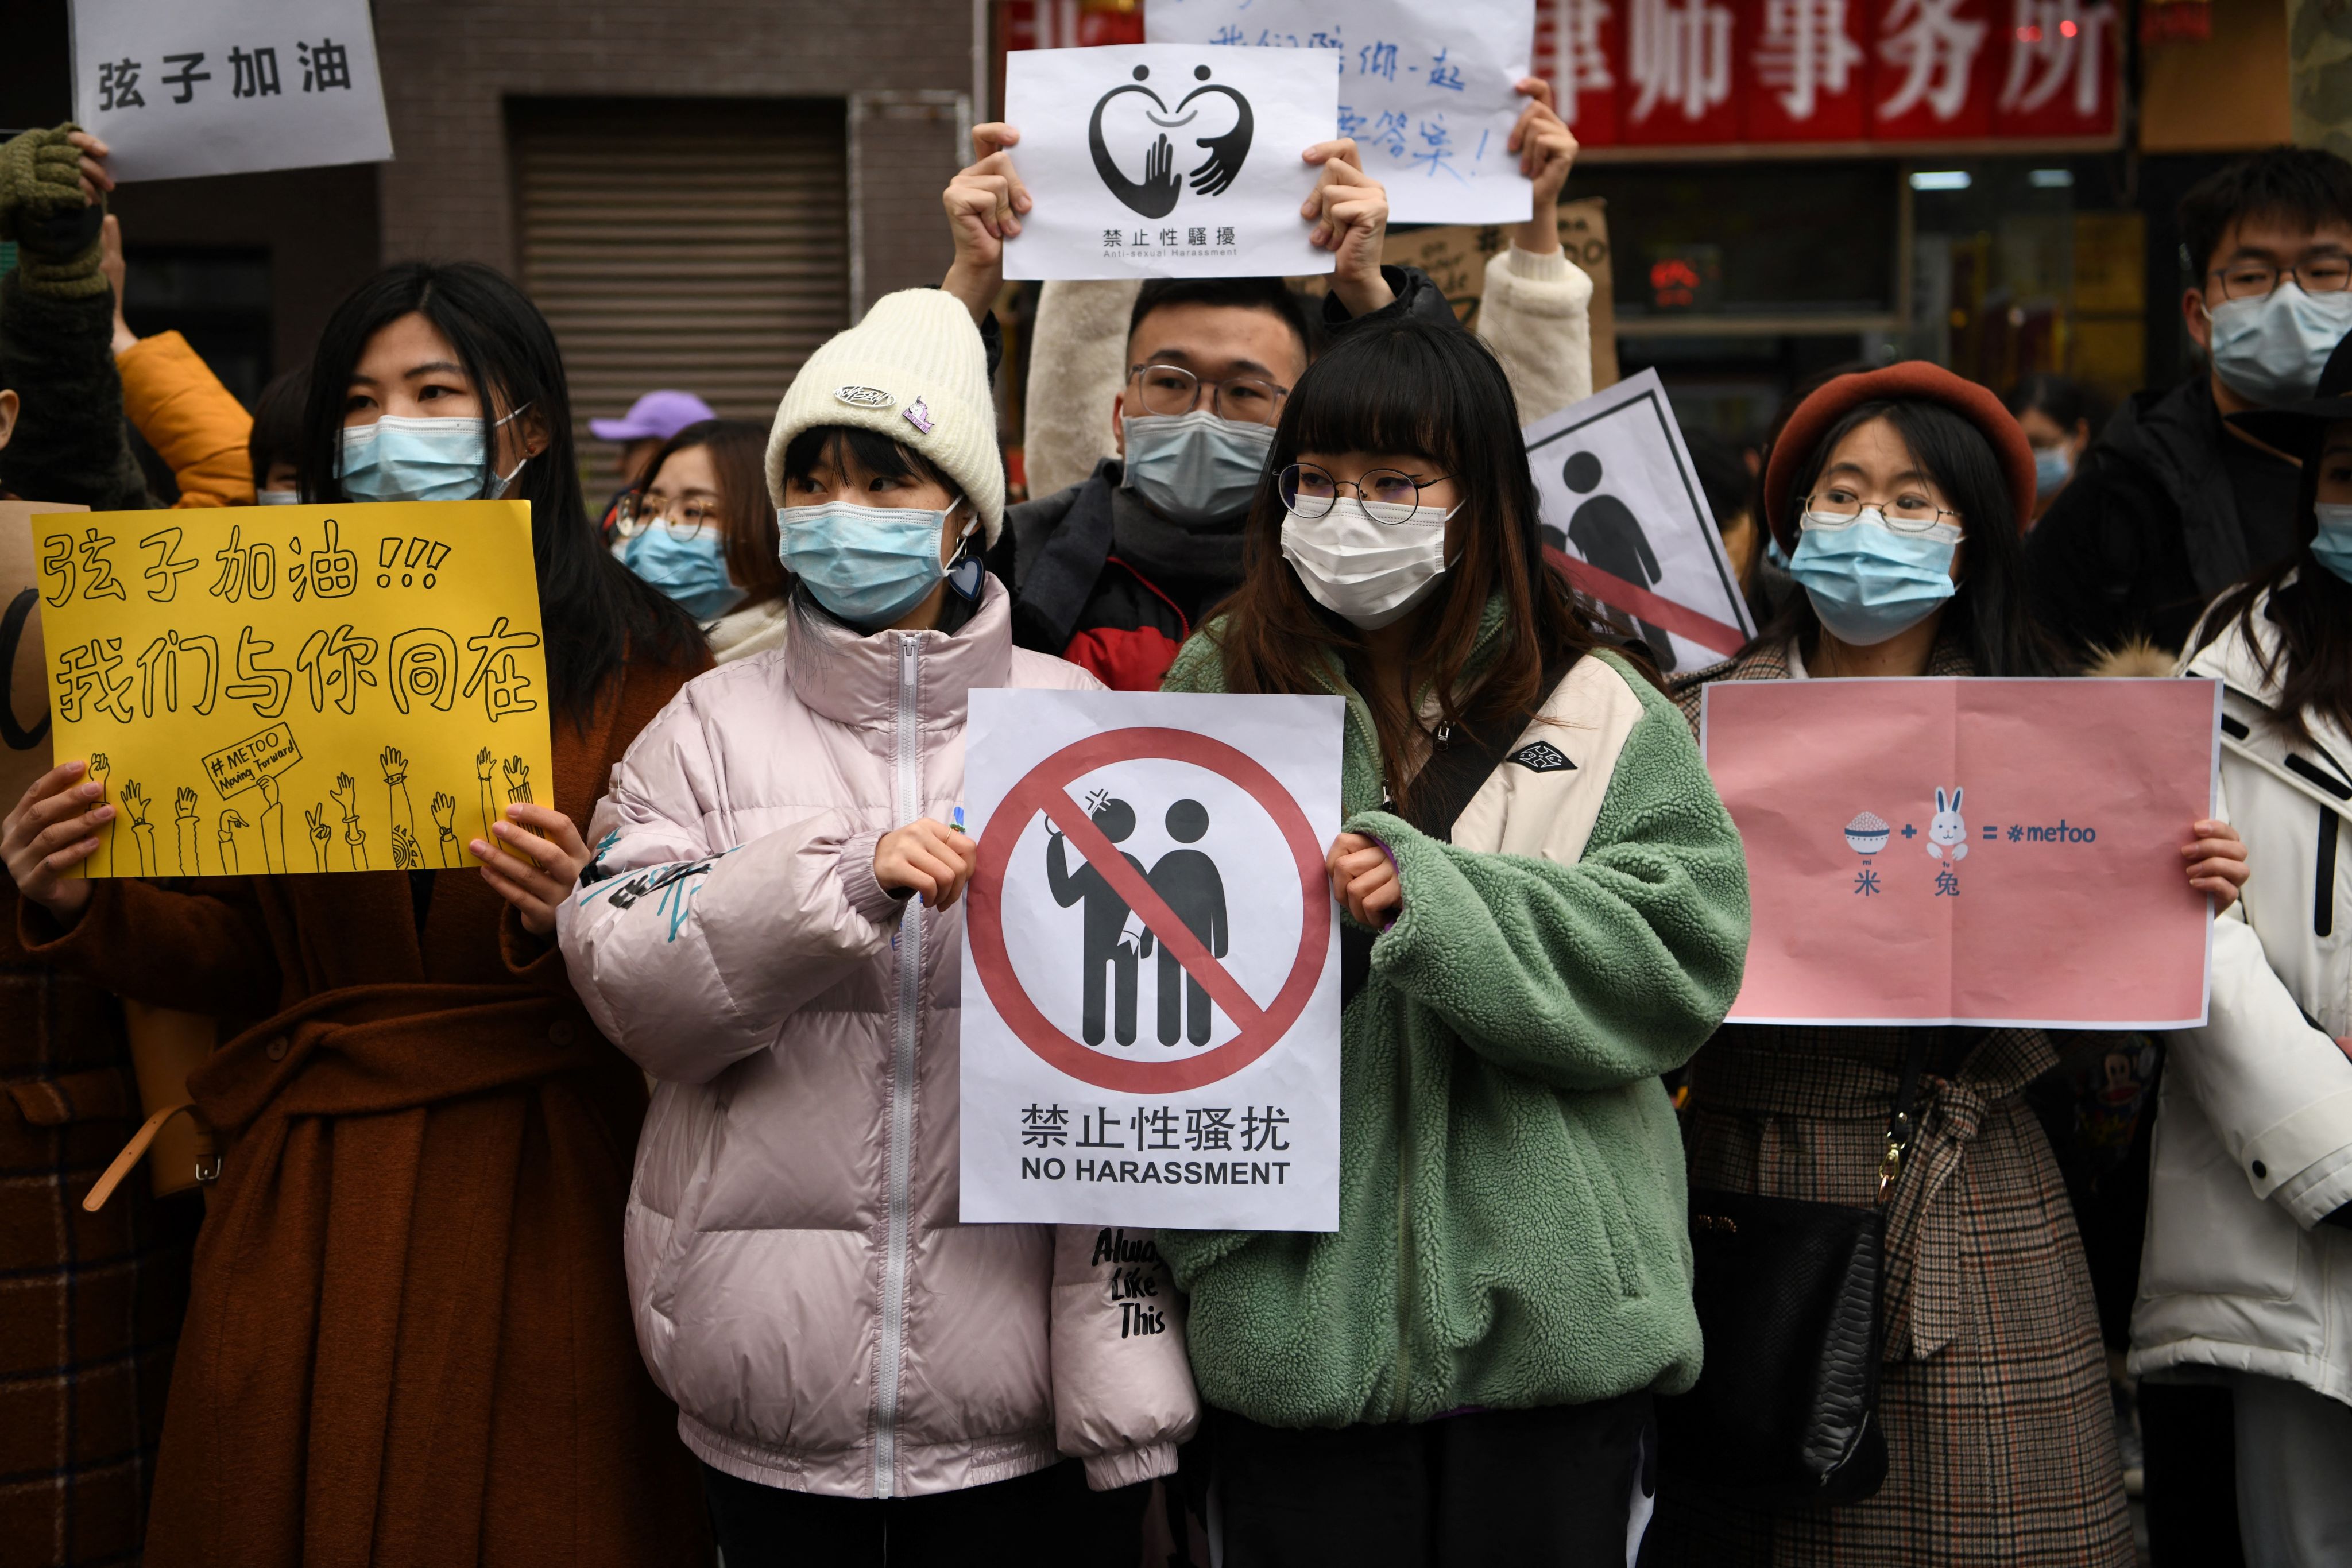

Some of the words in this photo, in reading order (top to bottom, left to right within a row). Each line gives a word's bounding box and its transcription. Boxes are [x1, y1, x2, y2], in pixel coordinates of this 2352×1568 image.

[99, 38, 352, 111] 弦子加油
[1103, 226, 1235, 247] 禁止性騷擾
[1104, 249, 1166, 257] Anti-sexual
[1171, 249, 1237, 257] Harassment
[44, 518, 452, 608] 弦子加油!!!
[56, 616, 540, 723] 我们与你同在
[219, 768, 256, 792] Moving
[253, 738, 295, 772] Forward
[2007, 819, 2096, 843] #metoo
[1854, 869, 1881, 896] 米
[1935, 870, 1960, 896] 兔
[1021, 1103, 1290, 1152] 禁止性骚扰
[1022, 1157, 1065, 1180] NO
[1076, 1159, 1290, 1185] HARASSMENT
[1112, 1267, 1158, 1301] Like
[1119, 1302, 1165, 1339] This
